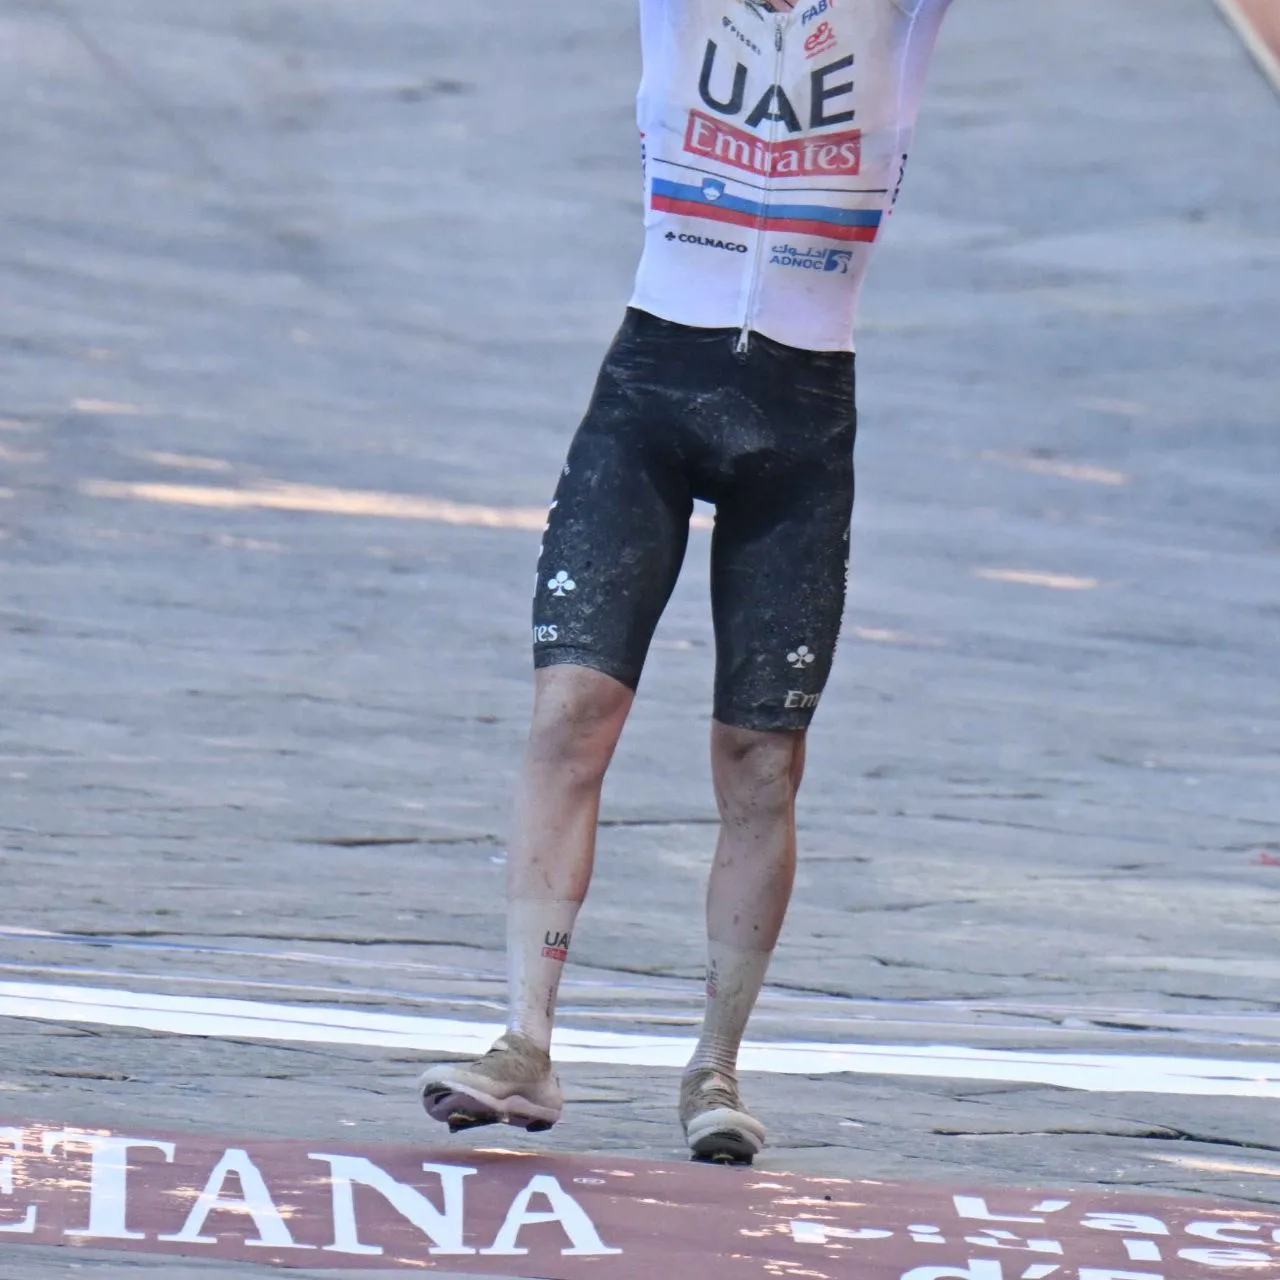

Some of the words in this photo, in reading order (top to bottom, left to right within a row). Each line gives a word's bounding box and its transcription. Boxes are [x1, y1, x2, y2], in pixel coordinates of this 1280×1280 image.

[698, 38, 856, 133] UAE
[689, 120, 857, 172] Emirates
[678, 233, 749, 254] COLNAGO
[770, 255, 825, 271] ADNOC
